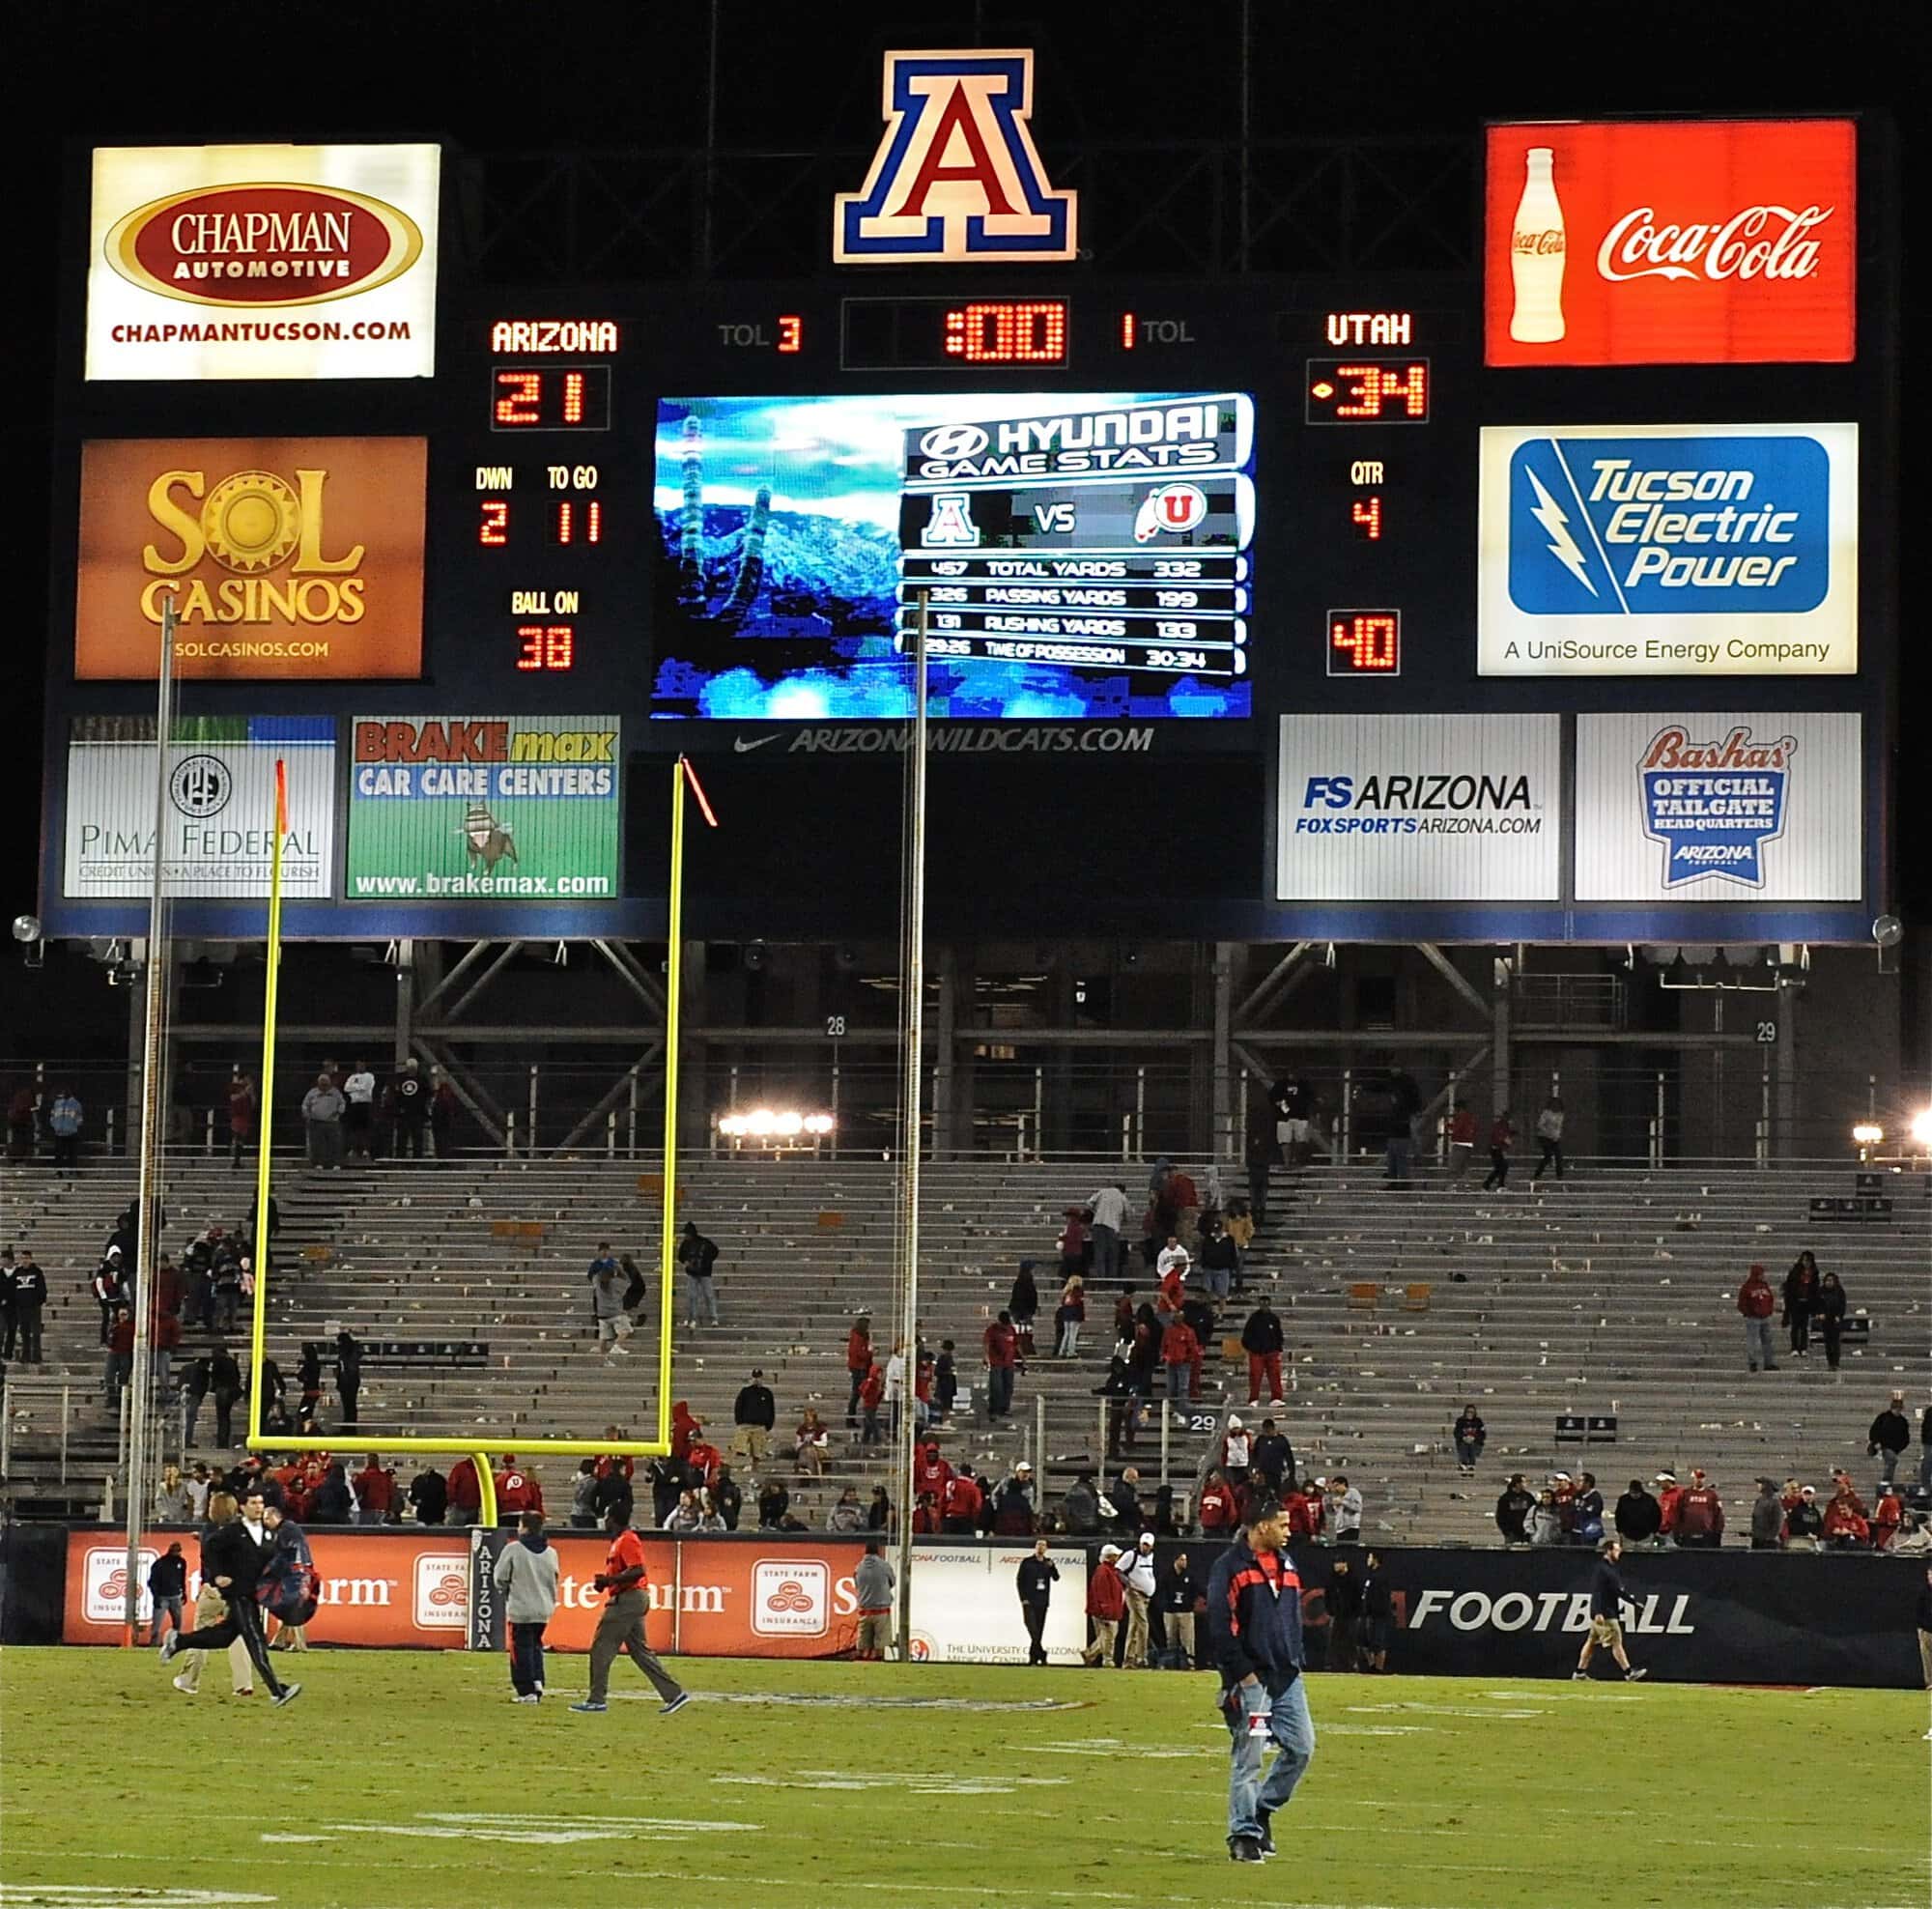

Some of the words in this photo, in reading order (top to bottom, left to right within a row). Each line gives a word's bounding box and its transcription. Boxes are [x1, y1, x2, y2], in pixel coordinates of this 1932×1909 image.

[834, 48, 1078, 264] A
[171, 212, 354, 256] CHAPMAN
[1596, 205, 1834, 282] Coca-Cola
[173, 259, 351, 279] AUTOMOTIVE
[111, 321, 412, 344] CHAPMANTUCSON.COM
[492, 321, 617, 354] ARIZONA
[719, 325, 769, 346] TOL
[778, 317, 801, 352] 3
[1123, 313, 1135, 349] 1
[1143, 320, 1194, 343] TOL
[1326, 314, 1411, 346] UTAH
[497, 374, 582, 423] 21
[1337, 366, 1425, 416] 34
[999, 405, 1218, 454] HYUNDAI
[920, 453, 1048, 479] GAME
[1058, 442, 1217, 471] STATS
[1350, 462, 1384, 486] QTR
[476, 467, 513, 490] DWN
[548, 467, 569, 489] TO
[573, 467, 597, 490] GO
[1589, 459, 1755, 502] Tucson
[559, 501, 601, 543] 11
[922, 493, 980, 548] A
[1034, 502, 1076, 532] VS
[1164, 495, 1193, 523] U
[1352, 496, 1380, 540] 4
[143, 470, 364, 577] SOL
[479, 502, 508, 545] 2
[1605, 503, 1799, 544] Electric
[930, 561, 969, 575] 457
[986, 561, 1048, 577] TOTAL
[1051, 561, 1126, 577] YARDS
[1152, 561, 1202, 578] 332
[1624, 547, 1798, 587] Power
[140, 579, 366, 624] CASINOS
[512, 592, 551, 614] BALL
[554, 592, 580, 614] ON
[930, 587, 969, 603] 326
[985, 588, 1060, 605] PASSING
[1062, 590, 1126, 607] YARDS
[1155, 591, 1198, 608] 199
[935, 613, 961, 629] 131
[984, 615, 1060, 634] RUSHING
[1062, 619, 1126, 637] YARDS
[1155, 622, 1197, 639] 133
[175, 641, 329, 657] SOLCASINOS.COM
[517, 627, 572, 670] 38
[984, 641, 1015, 657] TIME
[1015, 643, 1035, 658] OF
[1333, 618, 1395, 668] 40
[1504, 641, 1520, 658] A
[1527, 640, 1640, 659] UniSource
[1645, 640, 1720, 664] Energy
[1727, 639, 1831, 663] Company
[1146, 649, 1207, 669] 30:34
[355, 722, 509, 764] BRAKE
[510, 729, 619, 763] max
[1643, 731, 1792, 769] Bashas'
[357, 769, 412, 796] CAR
[419, 769, 491, 796] CARE
[497, 768, 612, 796] CENTERS
[1303, 776, 1354, 809] FS
[1353, 775, 1532, 811] ARIZONA
[1653, 779, 1776, 796] OFFICIAL
[1653, 799, 1775, 816] TAILGATE
[1295, 818, 1542, 834] FOXSPORTSARIZONA.COM
[1654, 818, 1774, 831] HEADQUARTERS
[183, 824, 320, 855] FEDERAL
[1673, 844, 1749, 859] ARIZONA
[80, 866, 125, 877] CREDIT
[193, 866, 230, 877] PLACE
[236, 867, 252, 877] TO
[355, 873, 610, 896] www.brakemax.com
[827, 1016, 845, 1036] 28
[1756, 1022, 1776, 1041] 29
[1189, 1414, 1216, 1431] 29
[477, 1545, 494, 1649] ARIZONA
